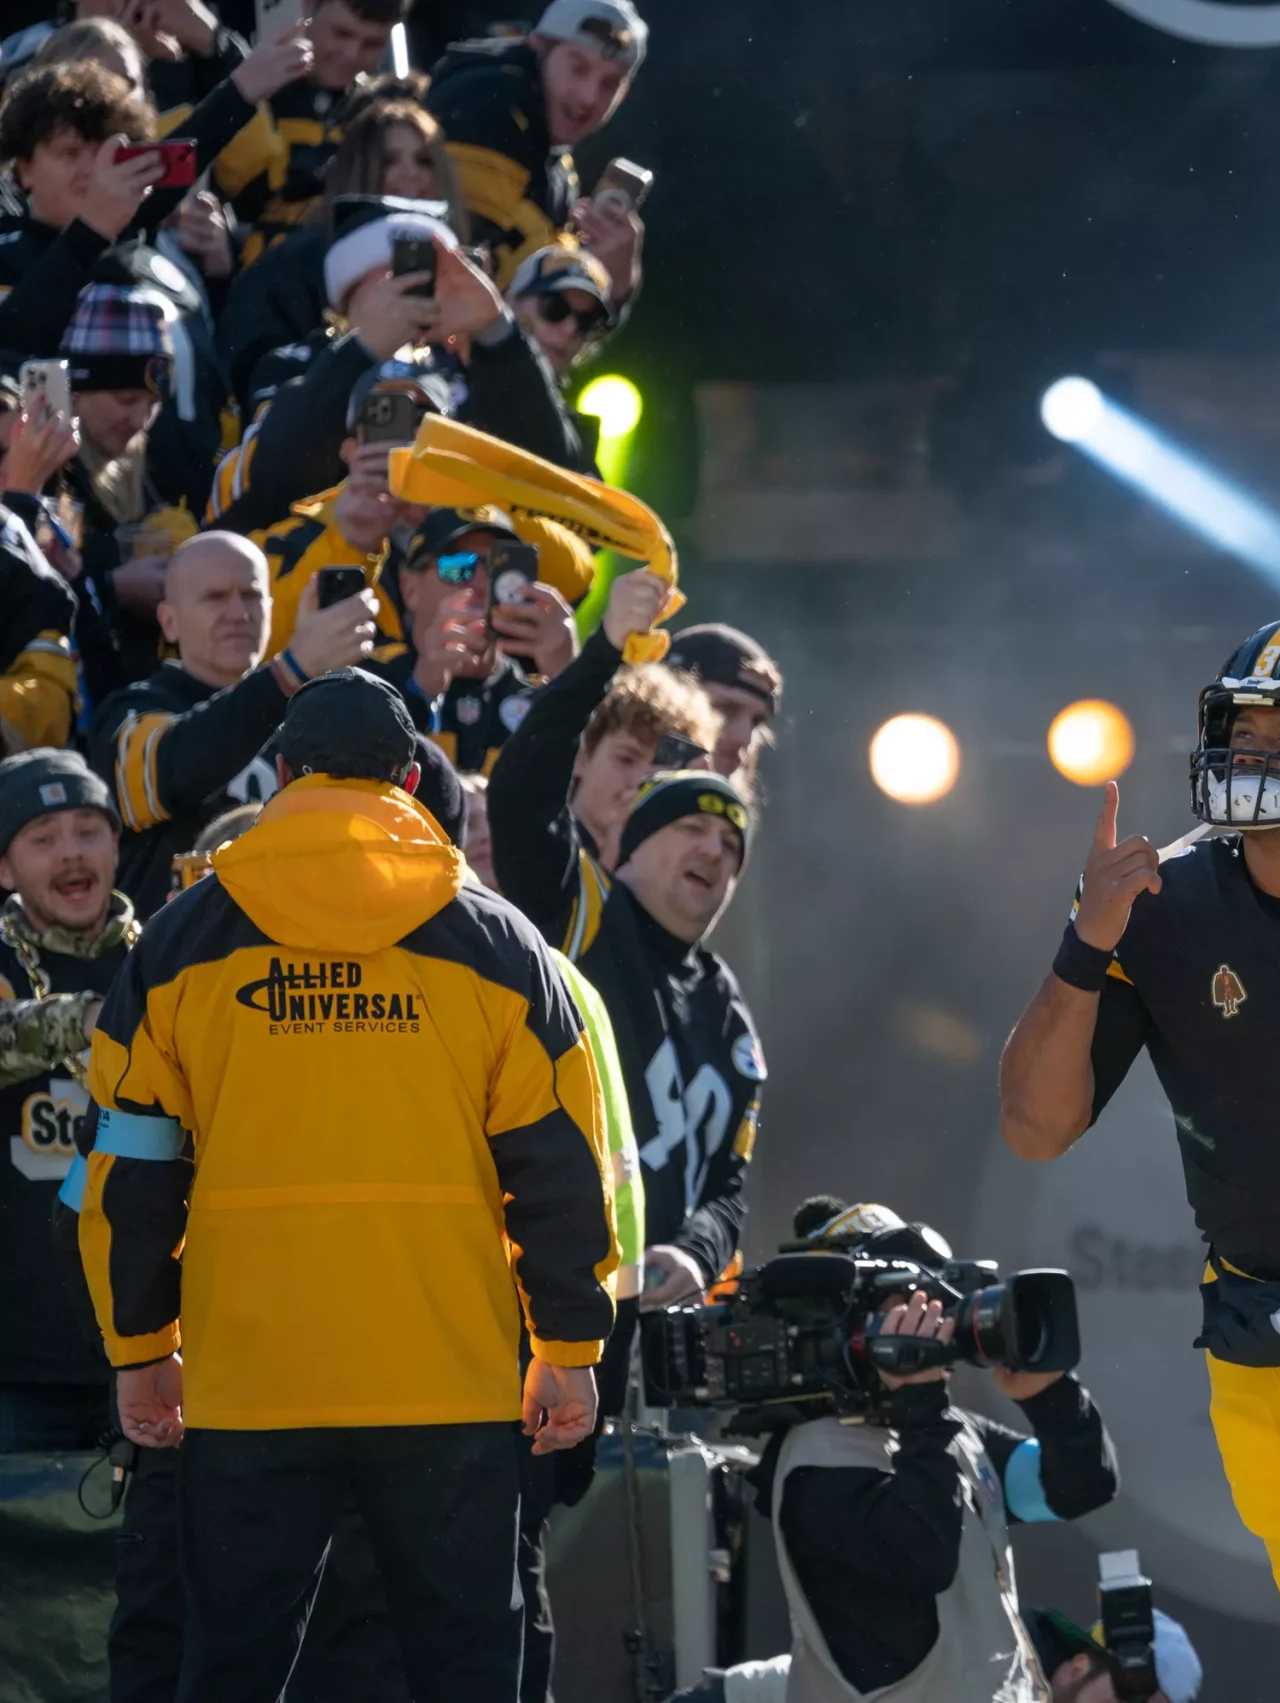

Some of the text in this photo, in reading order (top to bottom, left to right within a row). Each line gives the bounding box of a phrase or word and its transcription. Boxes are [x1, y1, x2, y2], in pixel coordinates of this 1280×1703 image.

[1253, 645, 1280, 676] 3
[268, 957, 362, 991] ALLIED
[268, 989, 420, 1022] UNIVERSAL
[269, 1021, 420, 1035] EVENT SERVICES
[1068, 1223, 1196, 1294] Stee
